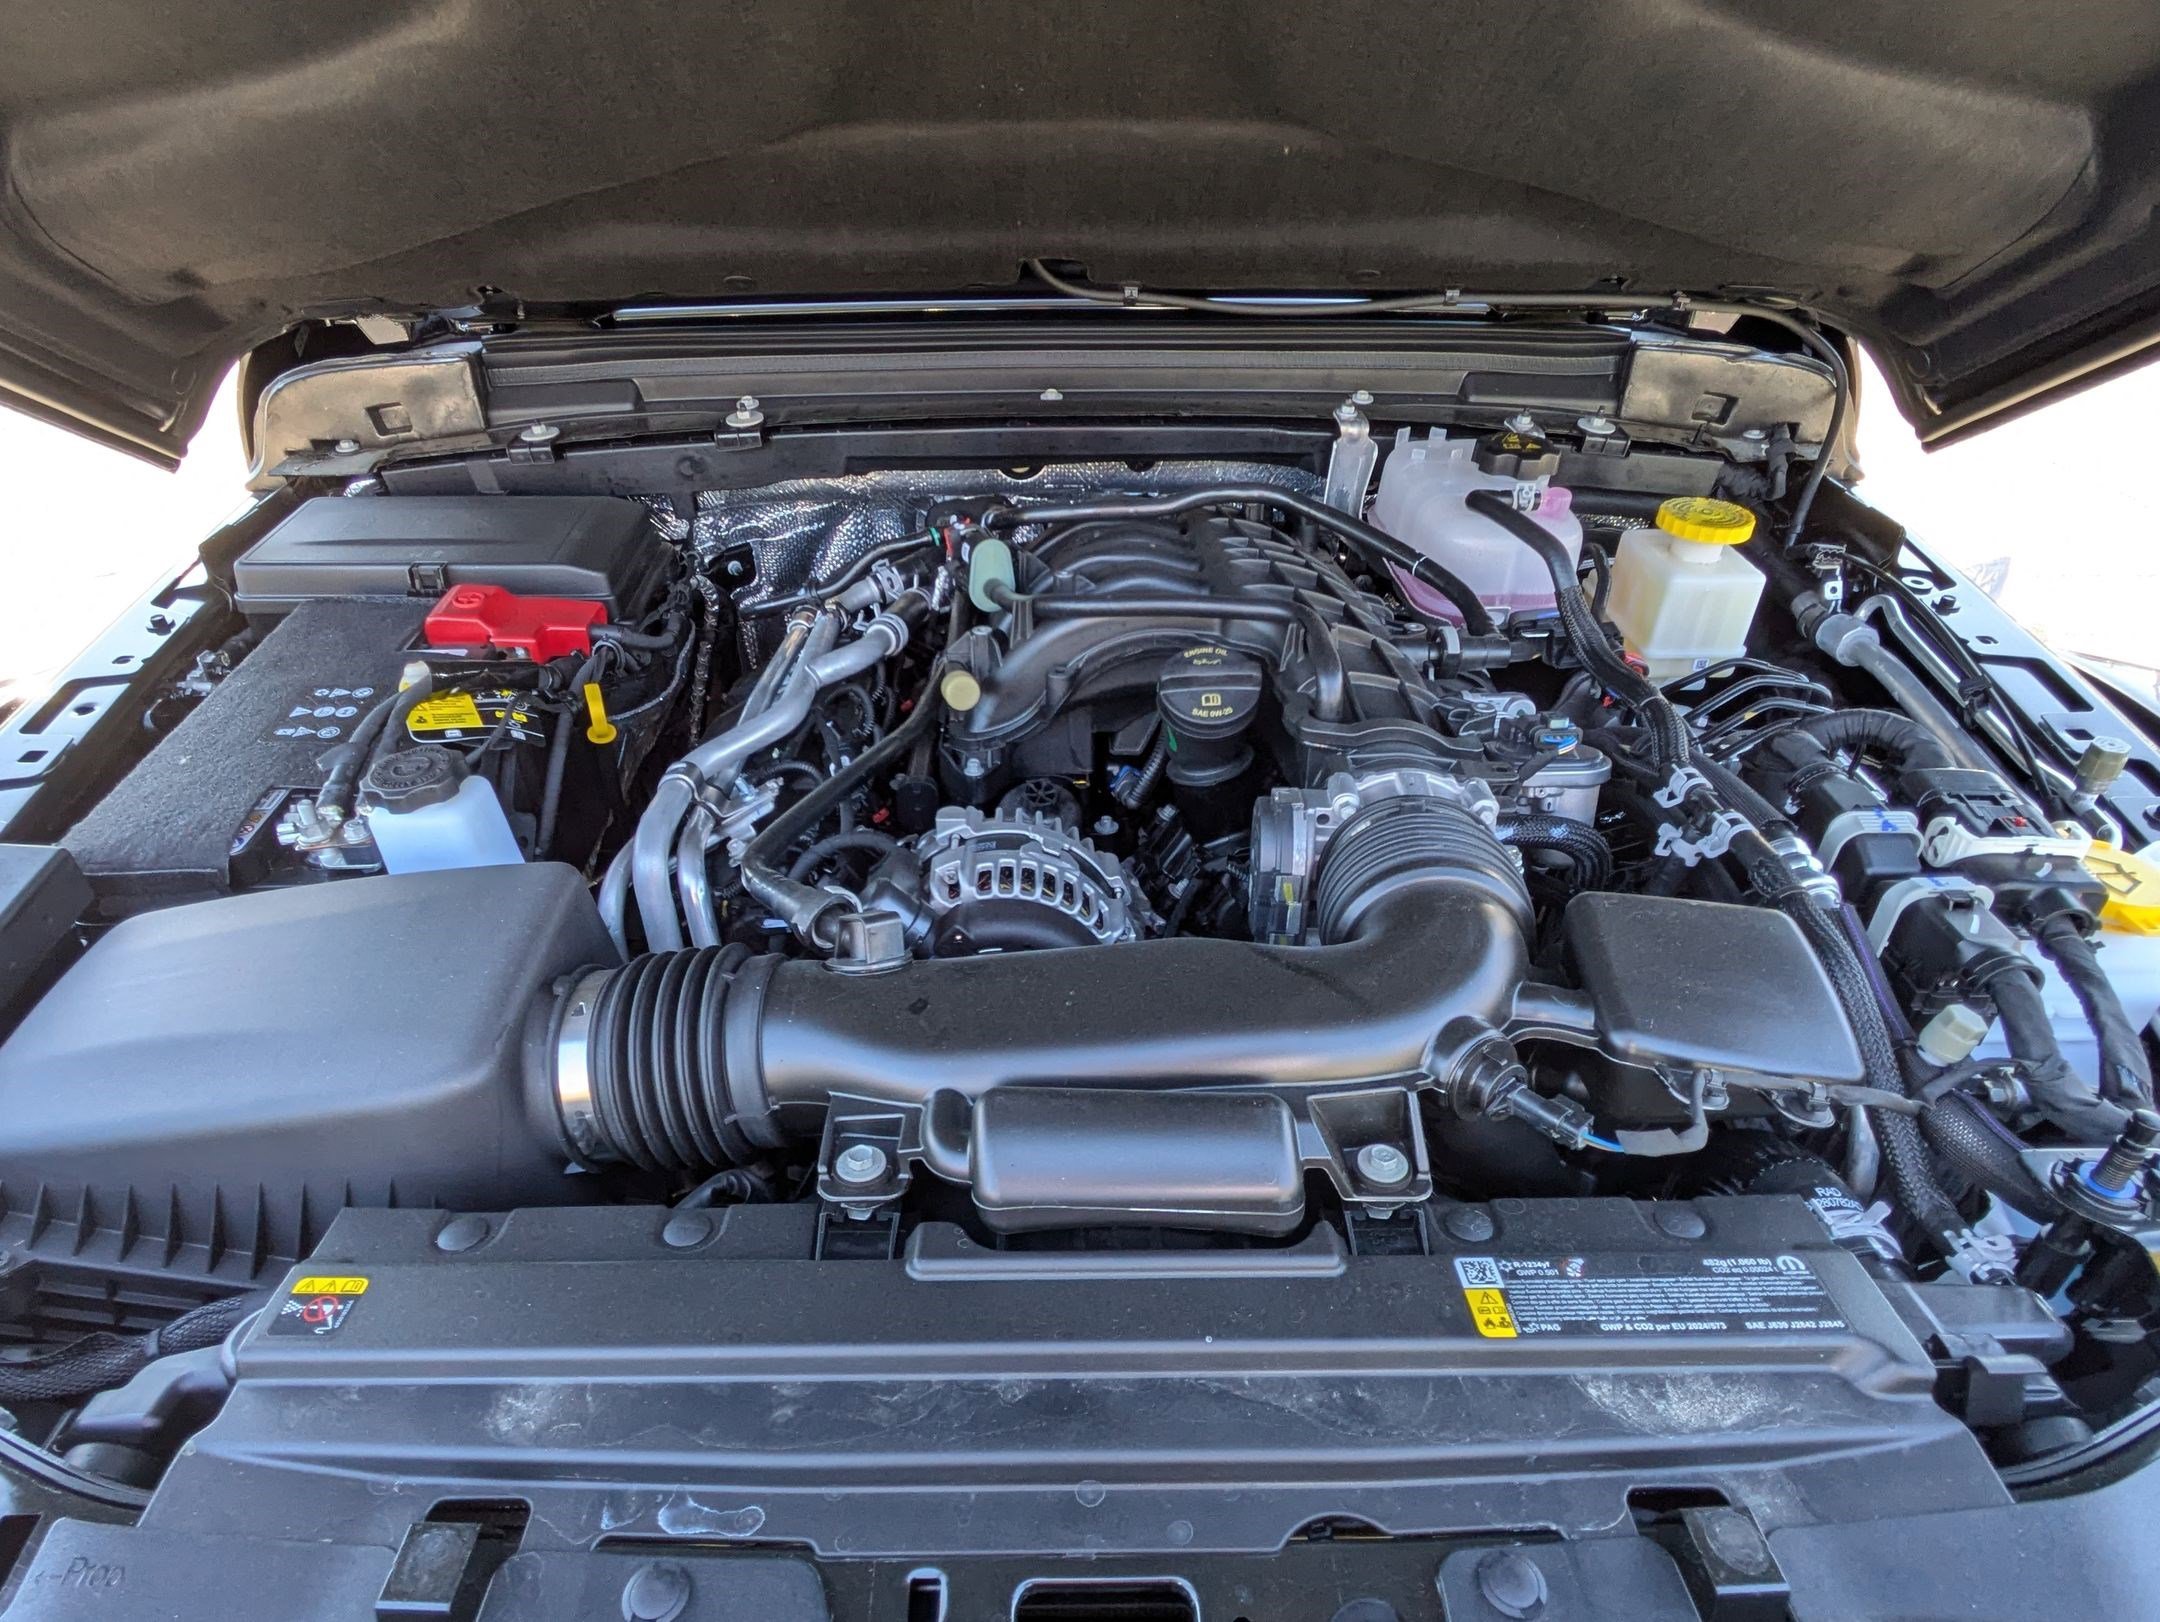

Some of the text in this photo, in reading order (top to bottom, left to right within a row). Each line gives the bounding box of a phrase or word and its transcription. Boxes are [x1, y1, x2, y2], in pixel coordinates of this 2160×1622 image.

[1184, 647, 1228, 658] ENGINE OIL
[1192, 708, 1208, 717] SAE
[1815, 1187, 1842, 1197] RAD
[1513, 1261, 1550, 1269] R-1234yf
[1541, 1323, 1561, 1331] PAG
[1600, 1323, 1623, 1331] GWP
[1625, 1323, 1633, 1331] &
[1634, 1323, 1655, 1331] CO2
[1656, 1323, 1670, 1332] per
[1672, 1322, 1686, 1330] EU
[1745, 1321, 1766, 1329] SAE
